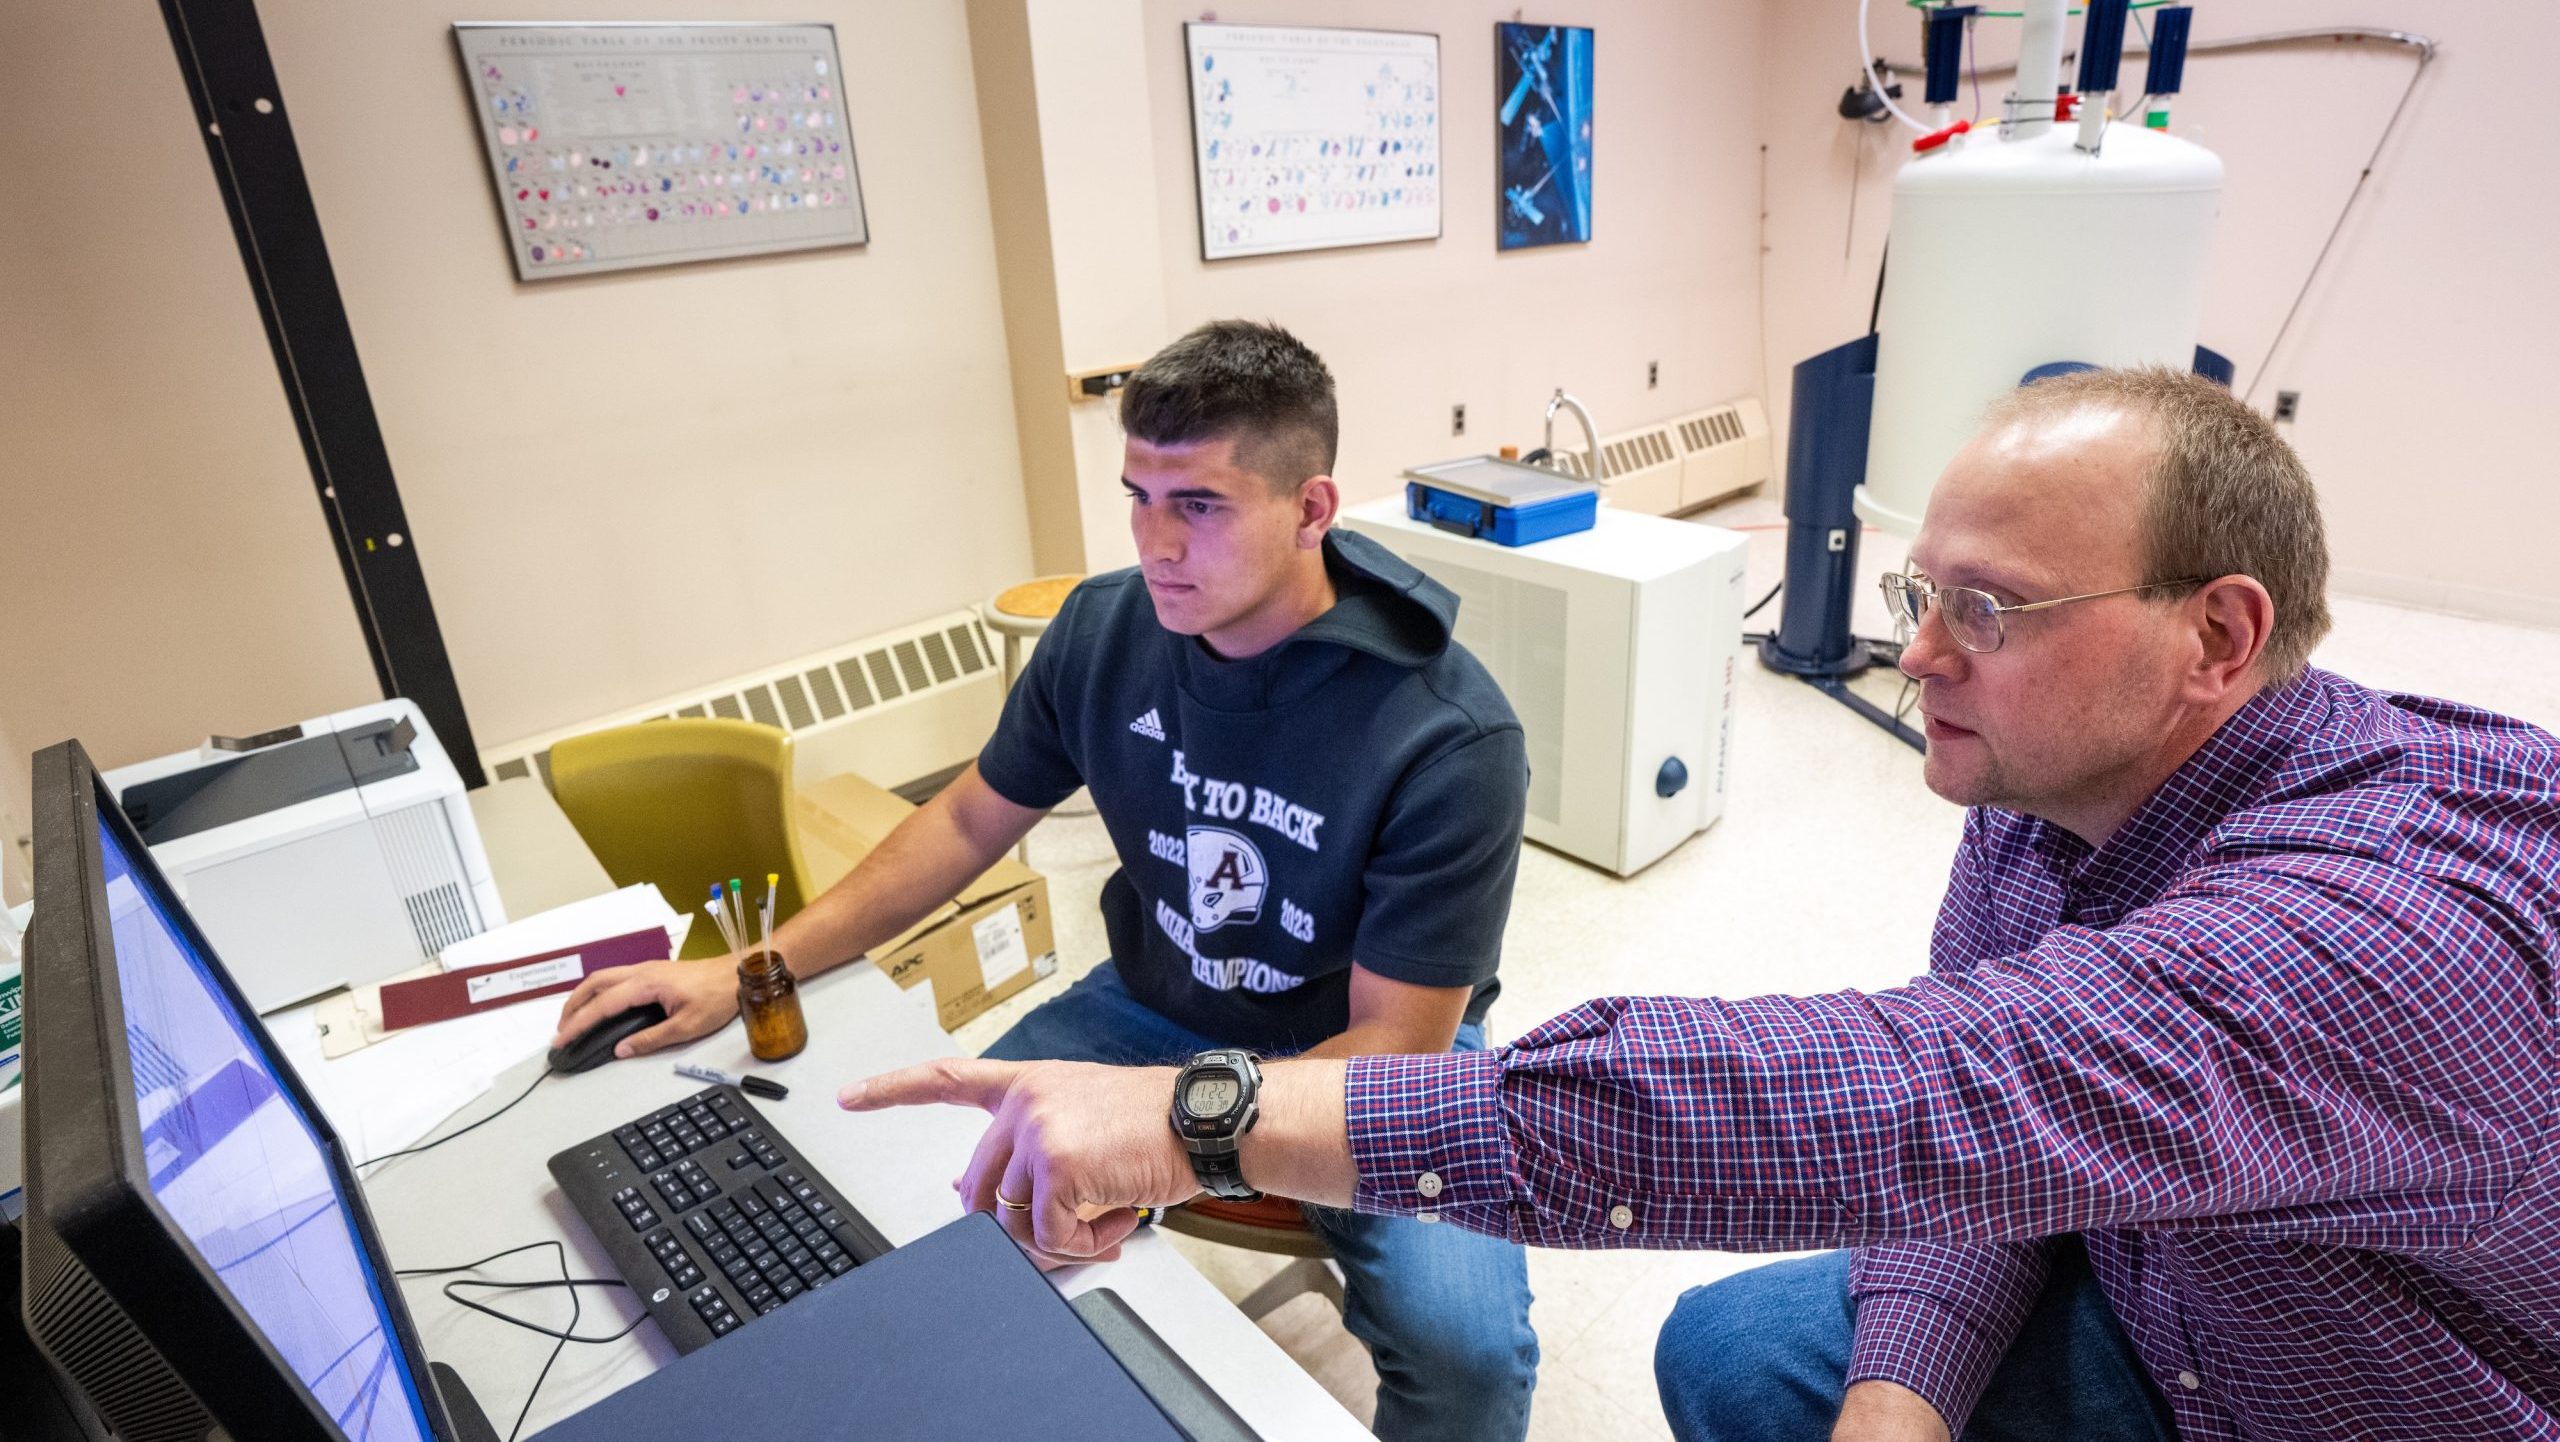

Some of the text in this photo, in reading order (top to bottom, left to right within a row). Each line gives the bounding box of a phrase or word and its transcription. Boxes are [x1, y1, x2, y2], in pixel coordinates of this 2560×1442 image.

[1129, 721, 1166, 742] adidas
[1202, 777, 1247, 820] TO
[1248, 786, 1326, 852] BACK
[1148, 829, 1187, 868] 2022
[1205, 850, 1245, 892] A
[1279, 897, 1316, 943] 2023
